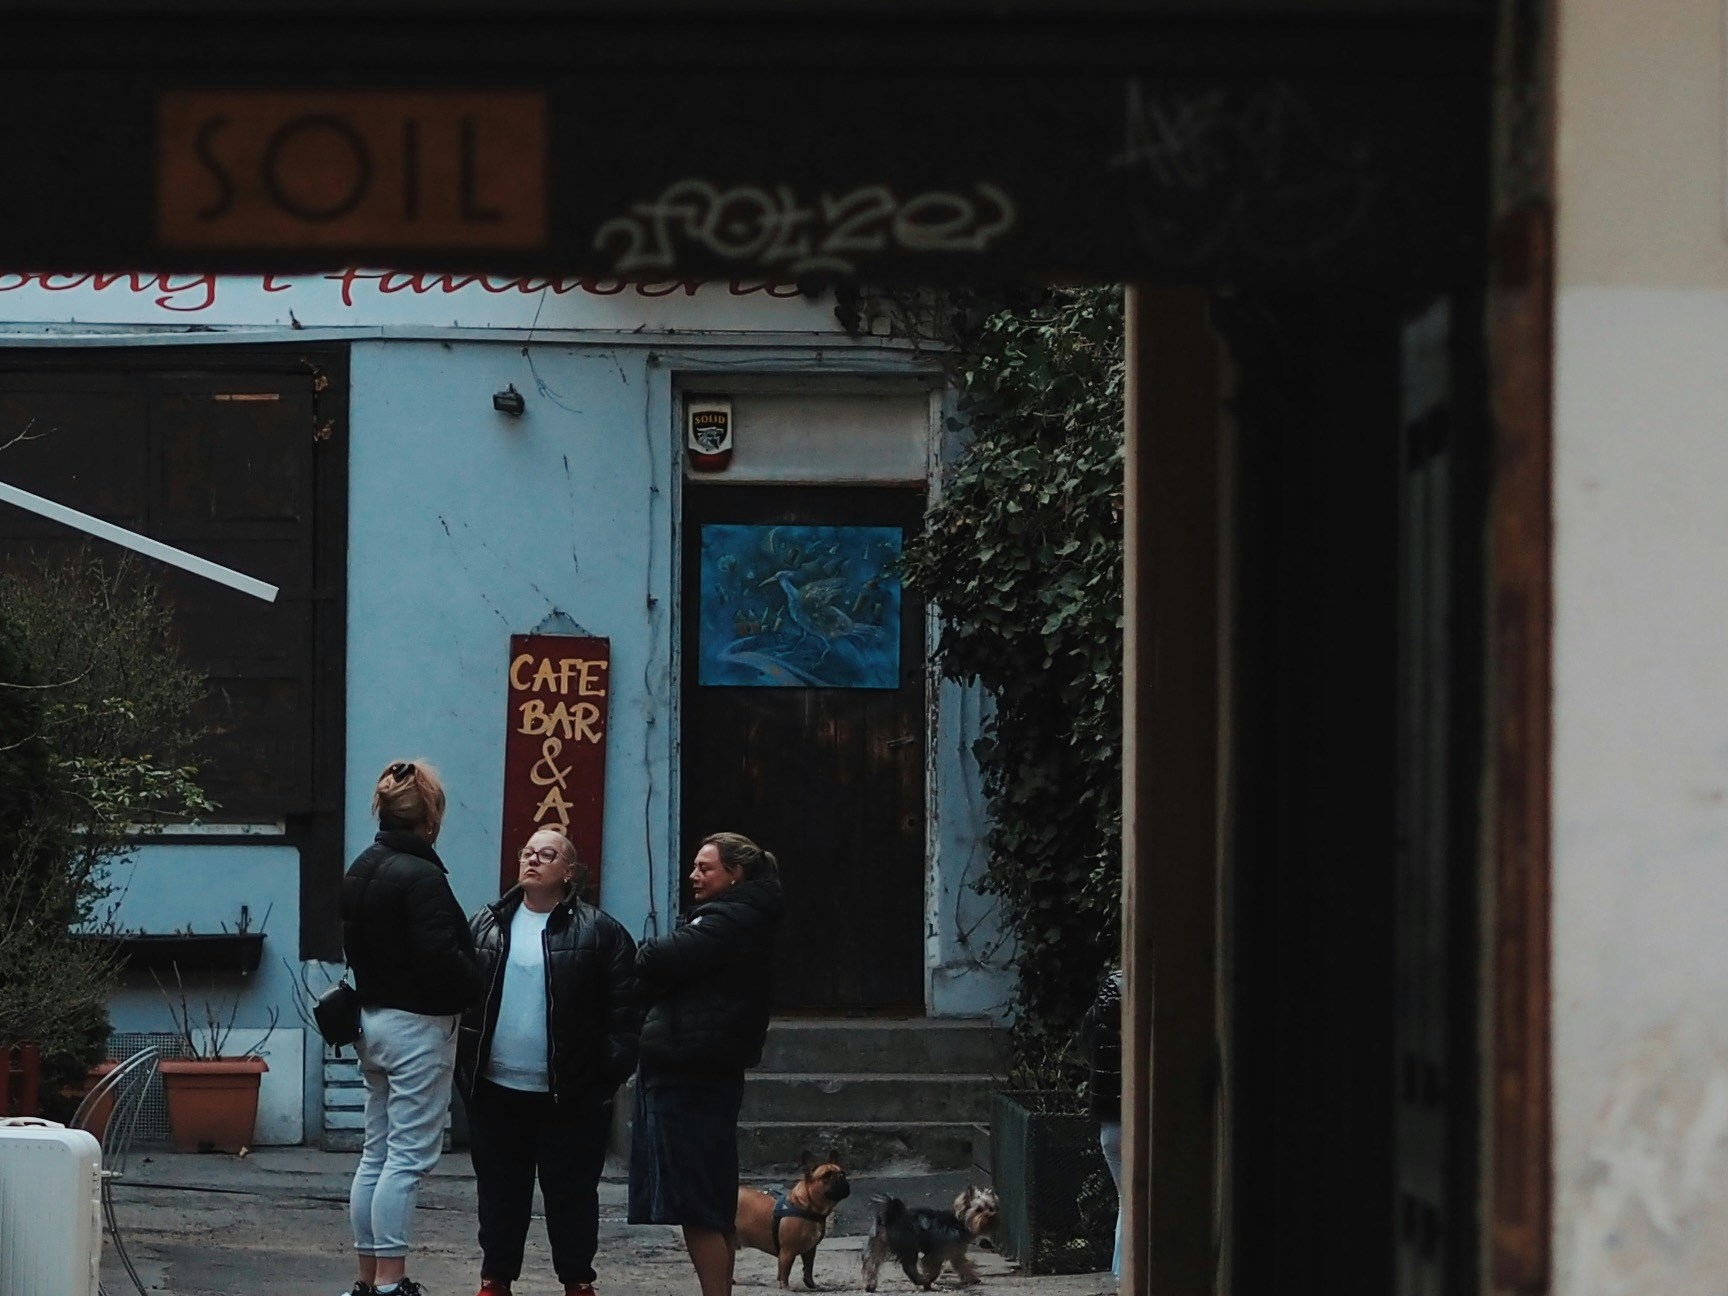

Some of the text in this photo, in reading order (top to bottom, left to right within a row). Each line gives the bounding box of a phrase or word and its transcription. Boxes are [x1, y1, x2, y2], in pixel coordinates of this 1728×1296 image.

[193, 111, 505, 224] SOIL
[694, 414, 726, 425] SOLID
[509, 652, 609, 697] CAFE
[516, 698, 603, 745] BAR
[529, 735, 574, 791] &
